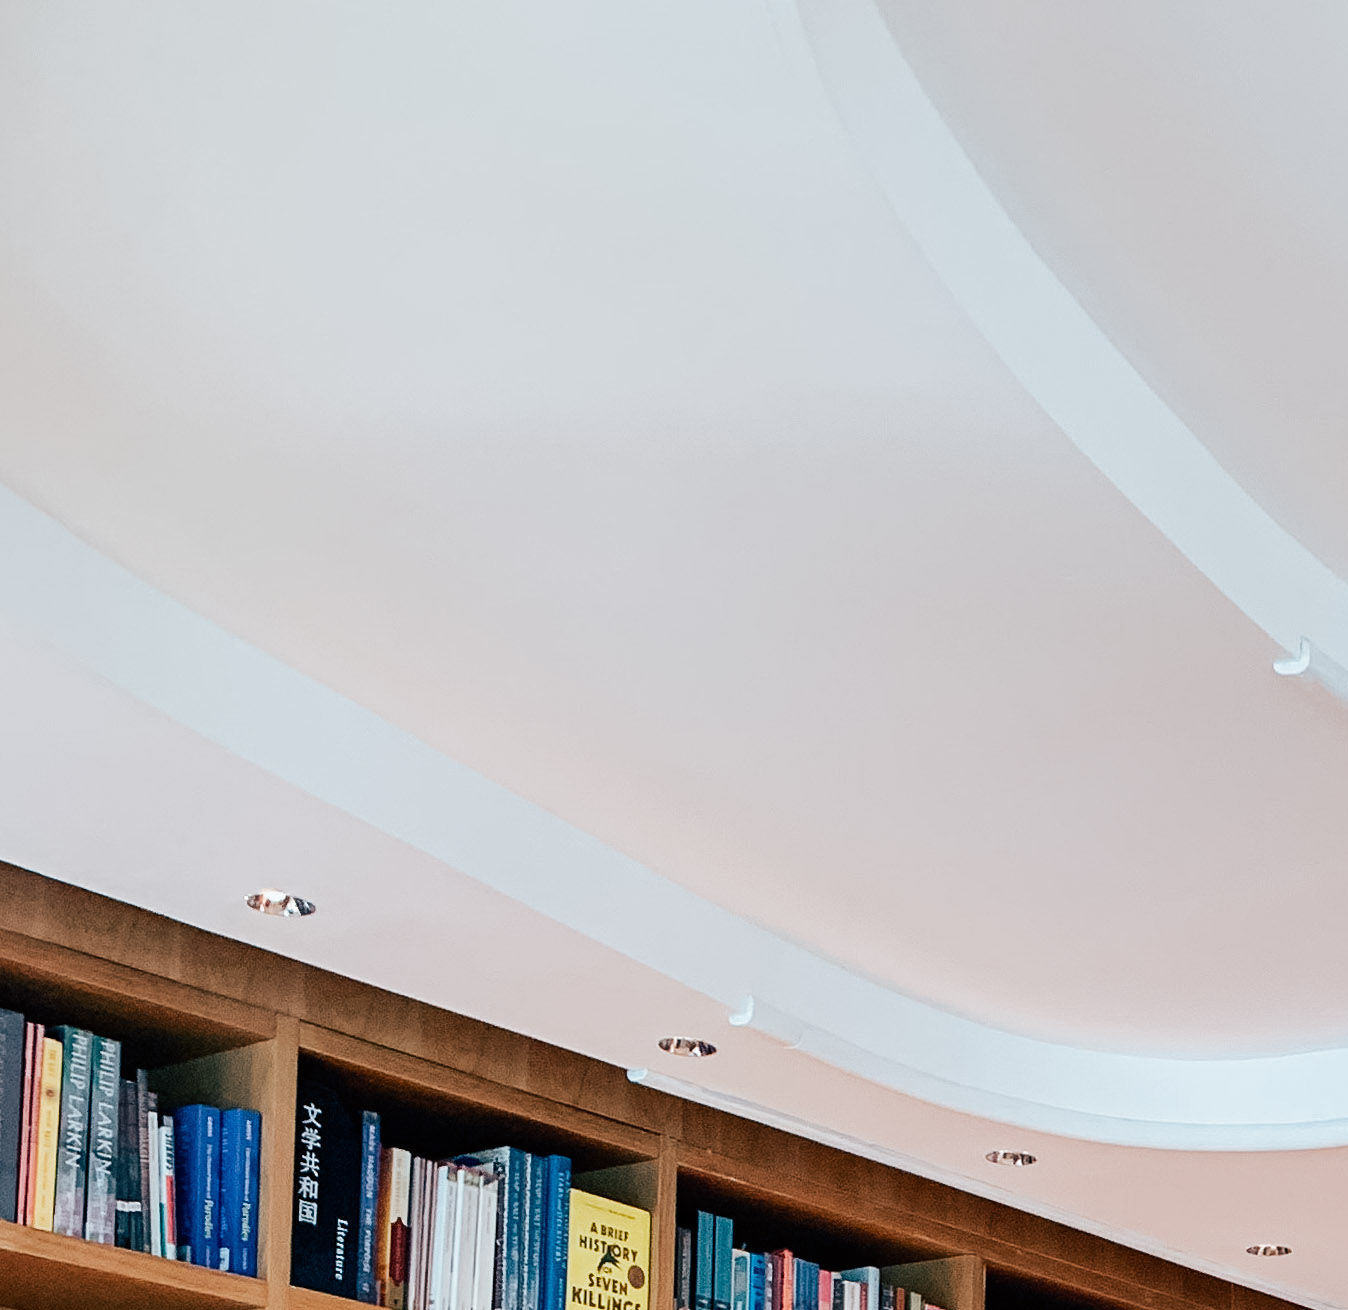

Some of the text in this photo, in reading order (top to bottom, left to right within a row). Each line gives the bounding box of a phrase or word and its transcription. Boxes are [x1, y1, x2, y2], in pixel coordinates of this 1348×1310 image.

[65, 1033, 89, 1168] PHILIP LARKIN
[95, 1041, 117, 1175] PHILIP LARKIN
[298, 1102, 322, 1226] 文学共和国
[204, 1199, 214, 1239] Parodies
[241, 1203, 252, 1241] Parodies
[590, 1222, 629, 1242] A BRIEF
[335, 1218, 348, 1281] Literature
[579, 1234, 638, 1263] HISTORY
[588, 1273, 628, 1296] SEVEN
